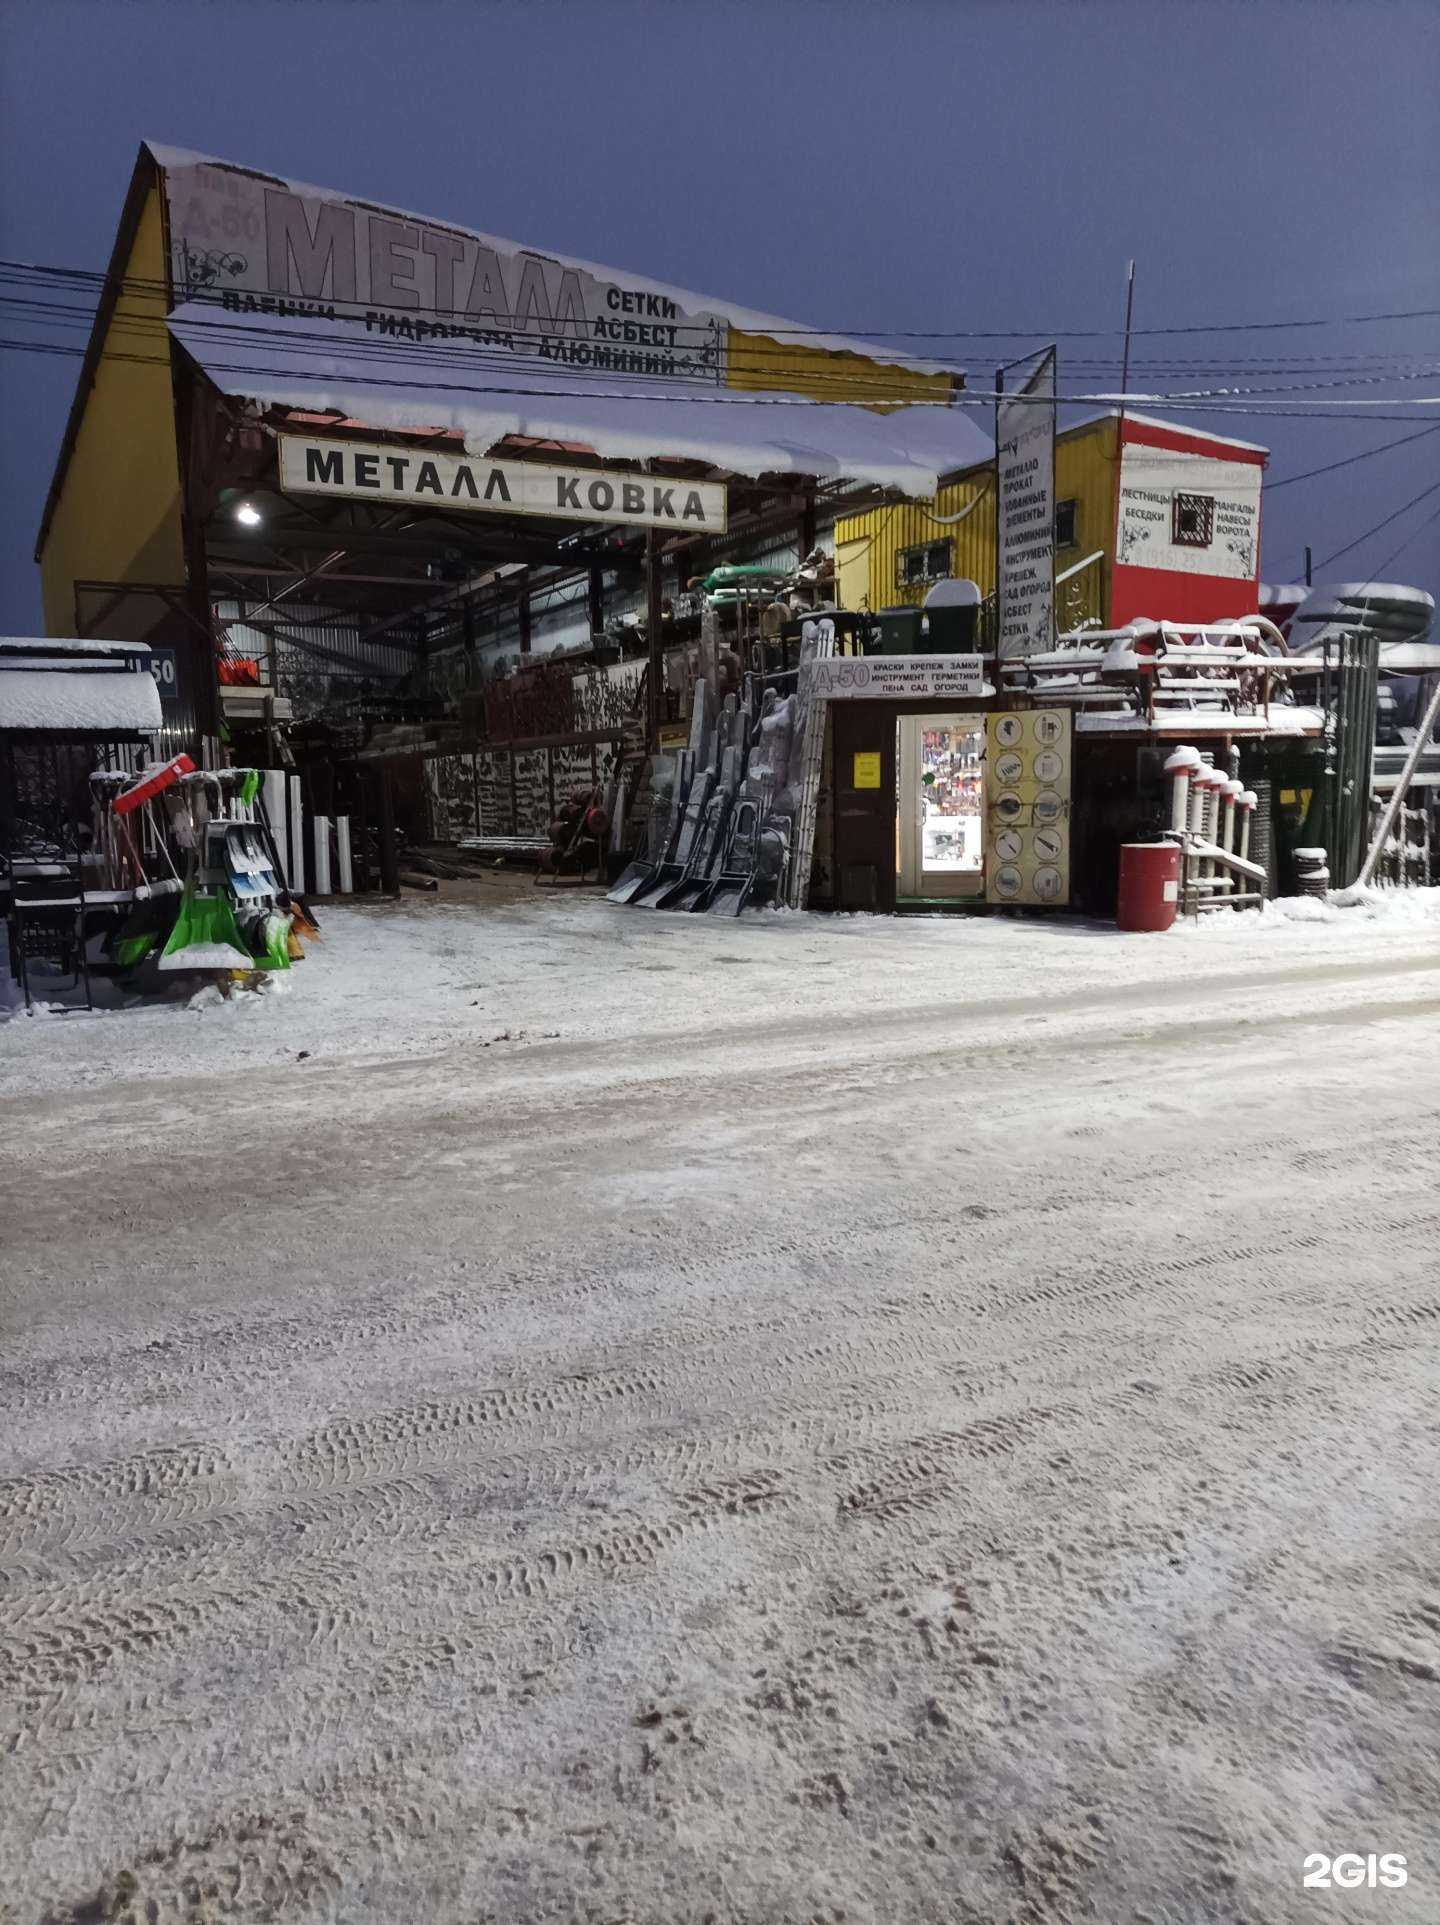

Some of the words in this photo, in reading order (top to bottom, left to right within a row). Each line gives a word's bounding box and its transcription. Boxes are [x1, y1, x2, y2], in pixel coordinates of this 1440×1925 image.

[263, 187, 588, 338] МЕТАЛЛ
[606, 287, 677, 320] СЕТКИ
[594, 315, 678, 347] АСБЕСТ
[538, 335, 675, 376] АЛЮМИНИЙ
[305, 448, 512, 502] МЕТАЛЛ
[556, 476, 707, 522] КОВКА
[1121, 488, 1171, 505] ЛЕСТНИЦЫ
[1125, 507, 1165, 522] БЕСЕДКИ
[1214, 501, 1256, 515] МАНГАЛЫ
[1217, 513, 1251, 526] НАВЕСЫ
[1216, 524, 1251, 538] ВОРОТА
[873, 663, 904, 672] КРАСКИ
[910, 662, 944, 671] КРЕПЕЖ
[950, 662, 979, 670] ЗАМКИ
[871, 673, 925, 683] ИНСТРУМЕНТ
[931, 672, 980, 681] ГЕРМЕТИКИ
[882, 684, 905, 692] ПЕНА
[911, 684, 928, 692] САД
[934, 683, 969, 692] ОГОРОД
